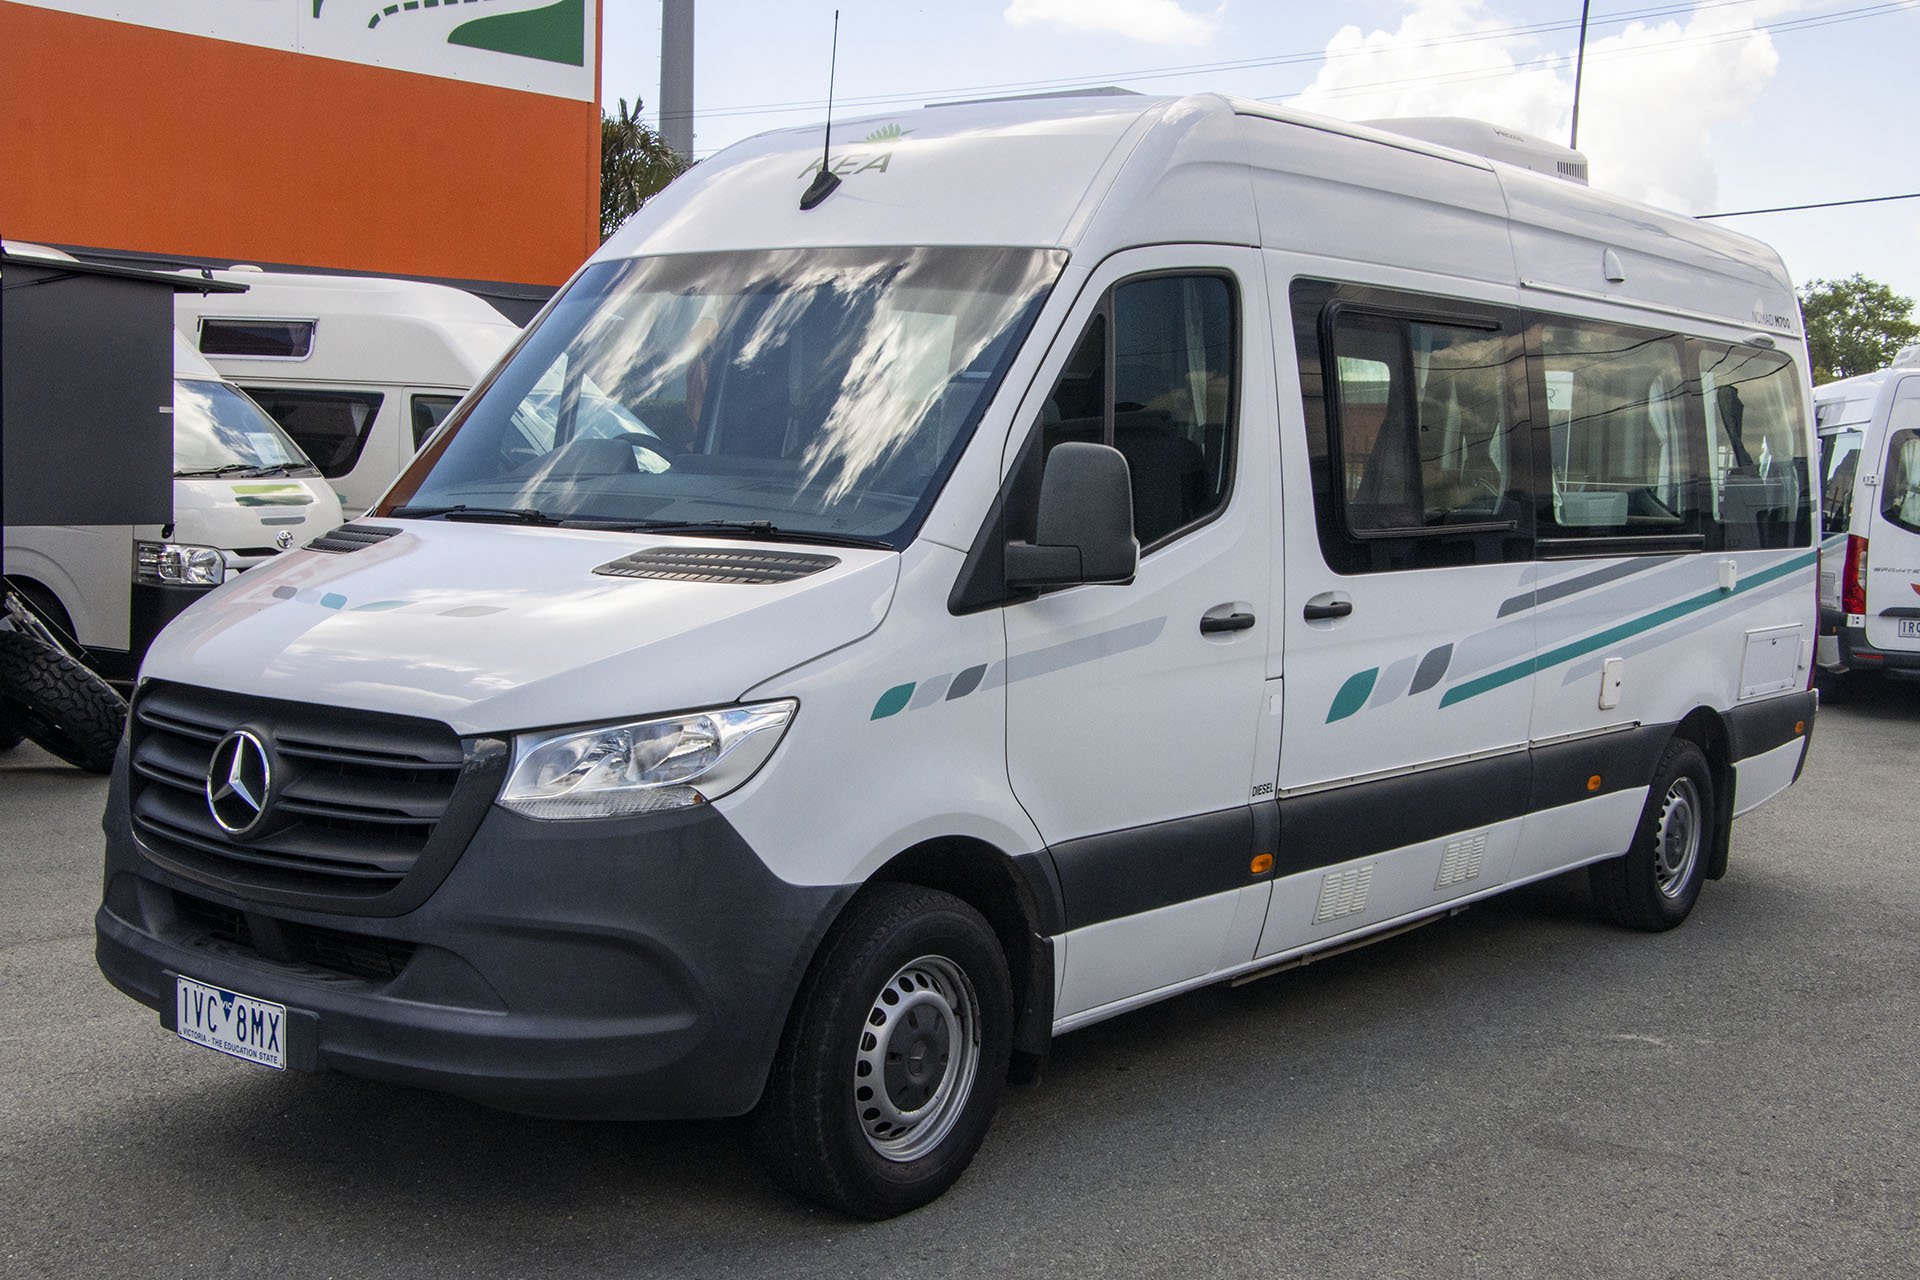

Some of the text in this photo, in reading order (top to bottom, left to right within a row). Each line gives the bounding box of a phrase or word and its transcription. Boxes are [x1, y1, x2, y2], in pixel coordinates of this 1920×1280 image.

[797, 152, 893, 179] KEA
[1252, 783, 1273, 797] DIESEL
[183, 987, 279, 1053] 1VC 8MX
[183, 1027, 206, 1042] VICTORIA
[212, 1037, 223, 1048] THE
[224, 1044, 257, 1058] EDUCATION
[259, 1052, 278, 1064] STATE
